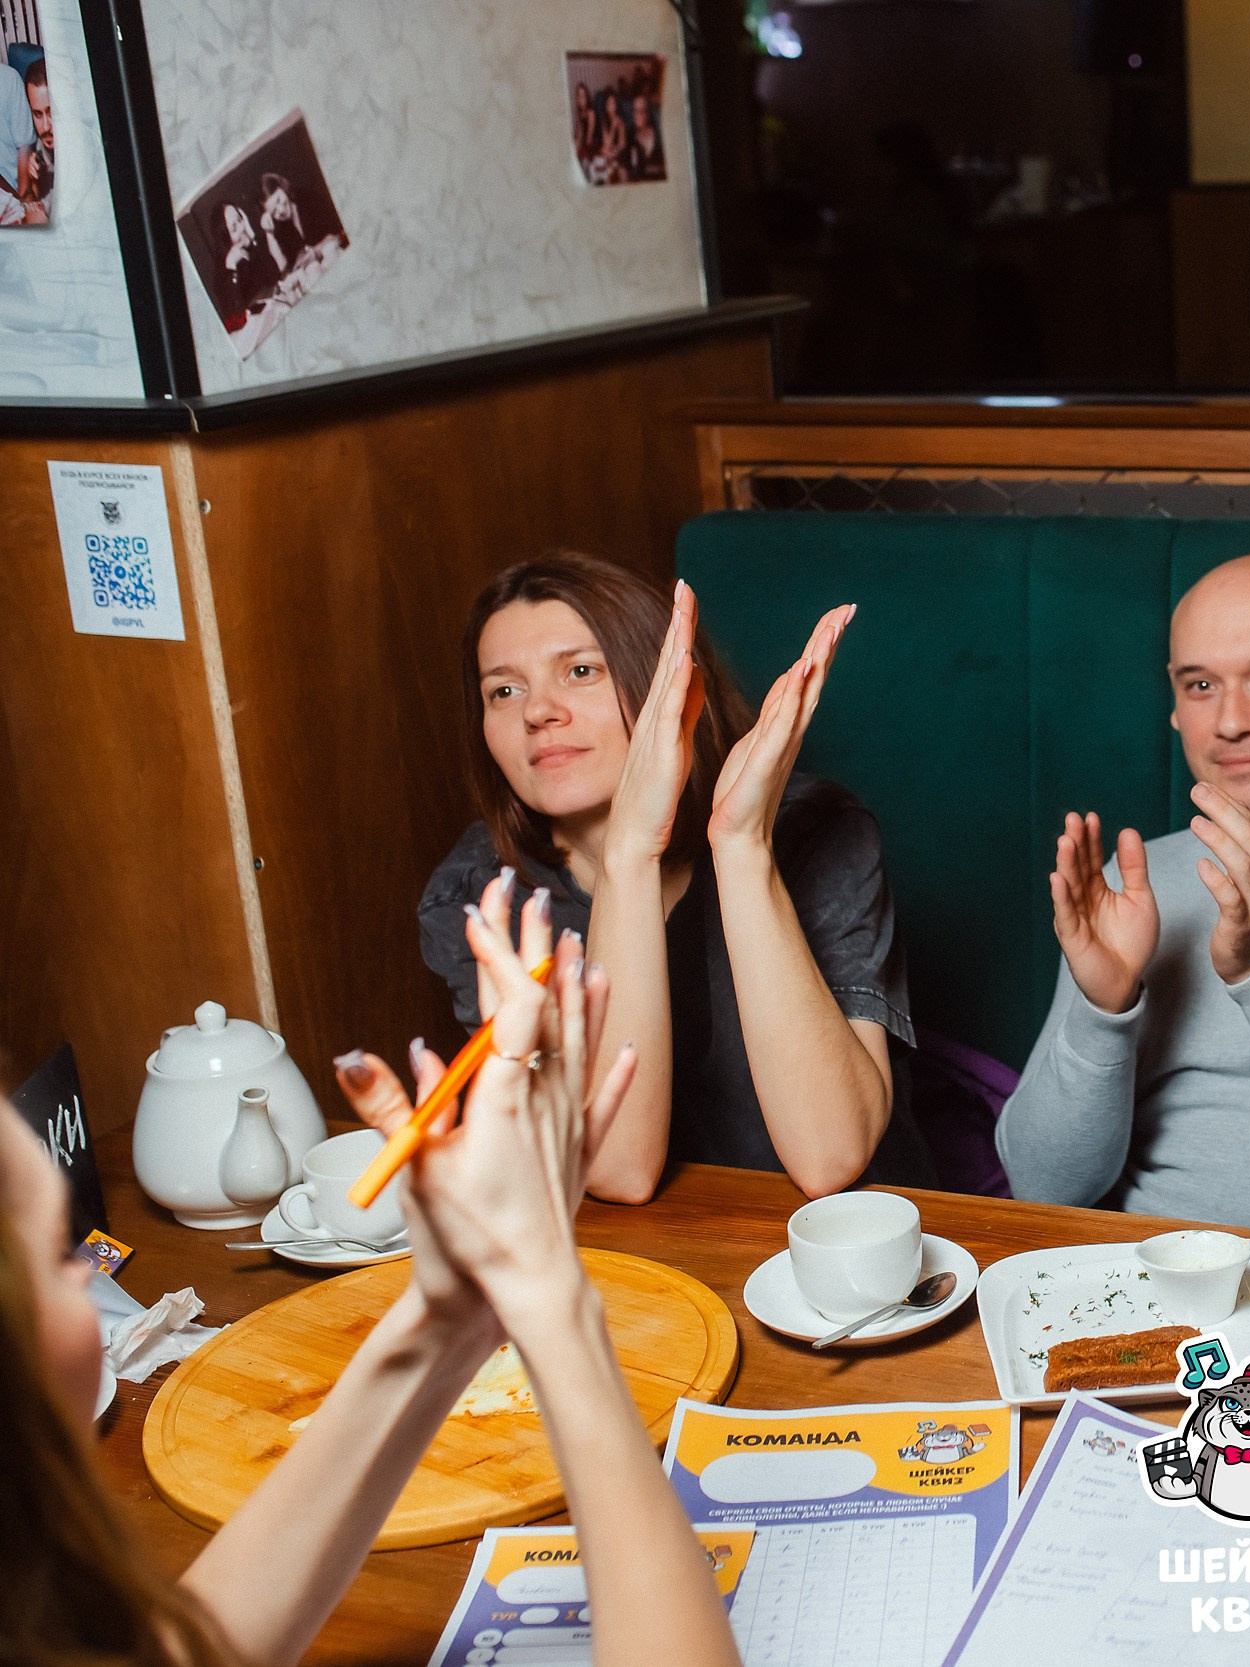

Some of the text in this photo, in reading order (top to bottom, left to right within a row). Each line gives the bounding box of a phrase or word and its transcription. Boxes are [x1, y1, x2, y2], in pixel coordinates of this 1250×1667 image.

[726, 1430, 862, 1447] КОМАНДА
[908, 1465, 976, 1479] ШЕЙКЕР
[918, 1478, 964, 1488] КВИЗ
[708, 1508, 754, 1517] СВЕРЯЕМ
[755, 1506, 783, 1515] СВОИ
[784, 1504, 827, 1513] ОТВЕТЫ,
[828, 1501, 874, 1510] КОТОРЫЕ
[885, 1498, 924, 1507] ЛЮБОМ
[925, 1495, 964, 1504] СЛУЧАЕ
[722, 1513, 800, 1522] ВЕЛИКОЛЕПНЫ,
[801, 1510, 830, 1520] ДАЖЕ
[832, 1508, 858, 1517] ЕСЛИ
[859, 1504, 939, 1515] НЕПРАВИЛЬНЫЕ
[491, 1612, 519, 1621] ТУР
